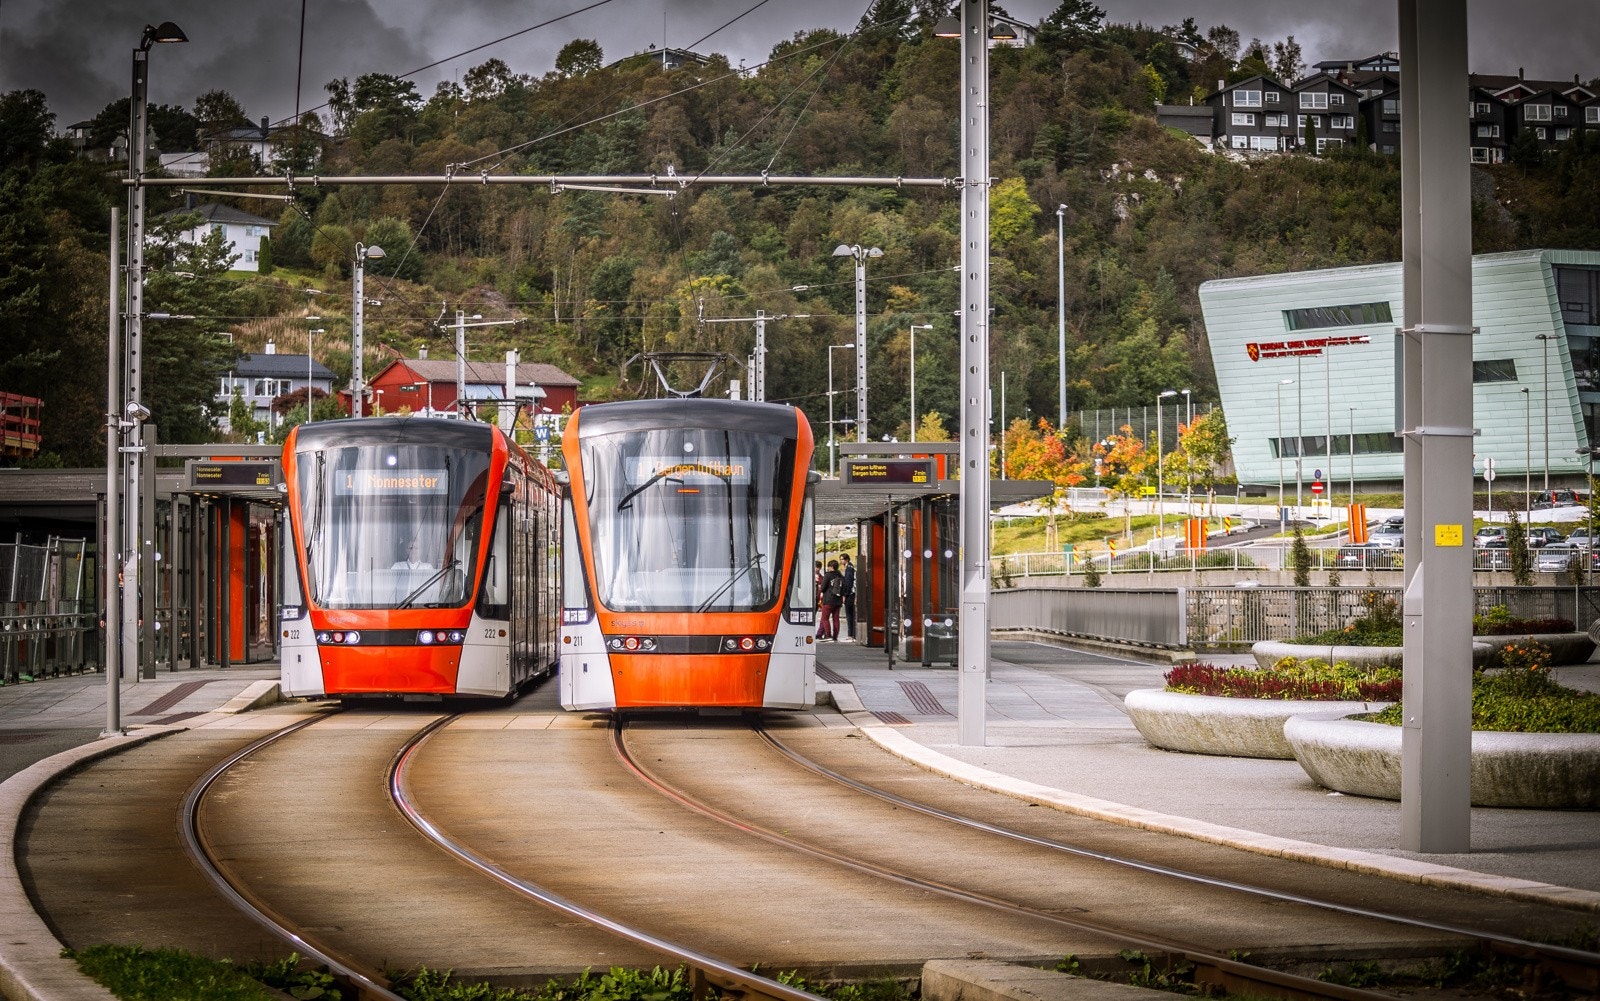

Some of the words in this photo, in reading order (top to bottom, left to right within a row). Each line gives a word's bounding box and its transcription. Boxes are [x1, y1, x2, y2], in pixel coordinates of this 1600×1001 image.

[536, 428, 548, 439] W
[656, 460, 695, 479] Bergen
[346, 474, 353, 489] 1
[367, 474, 438, 489] Nonneseter
[290, 629, 300, 639] 222
[484, 628, 496, 638] 222
[573, 636, 583, 647] 211
[794, 636, 804, 647] 211
